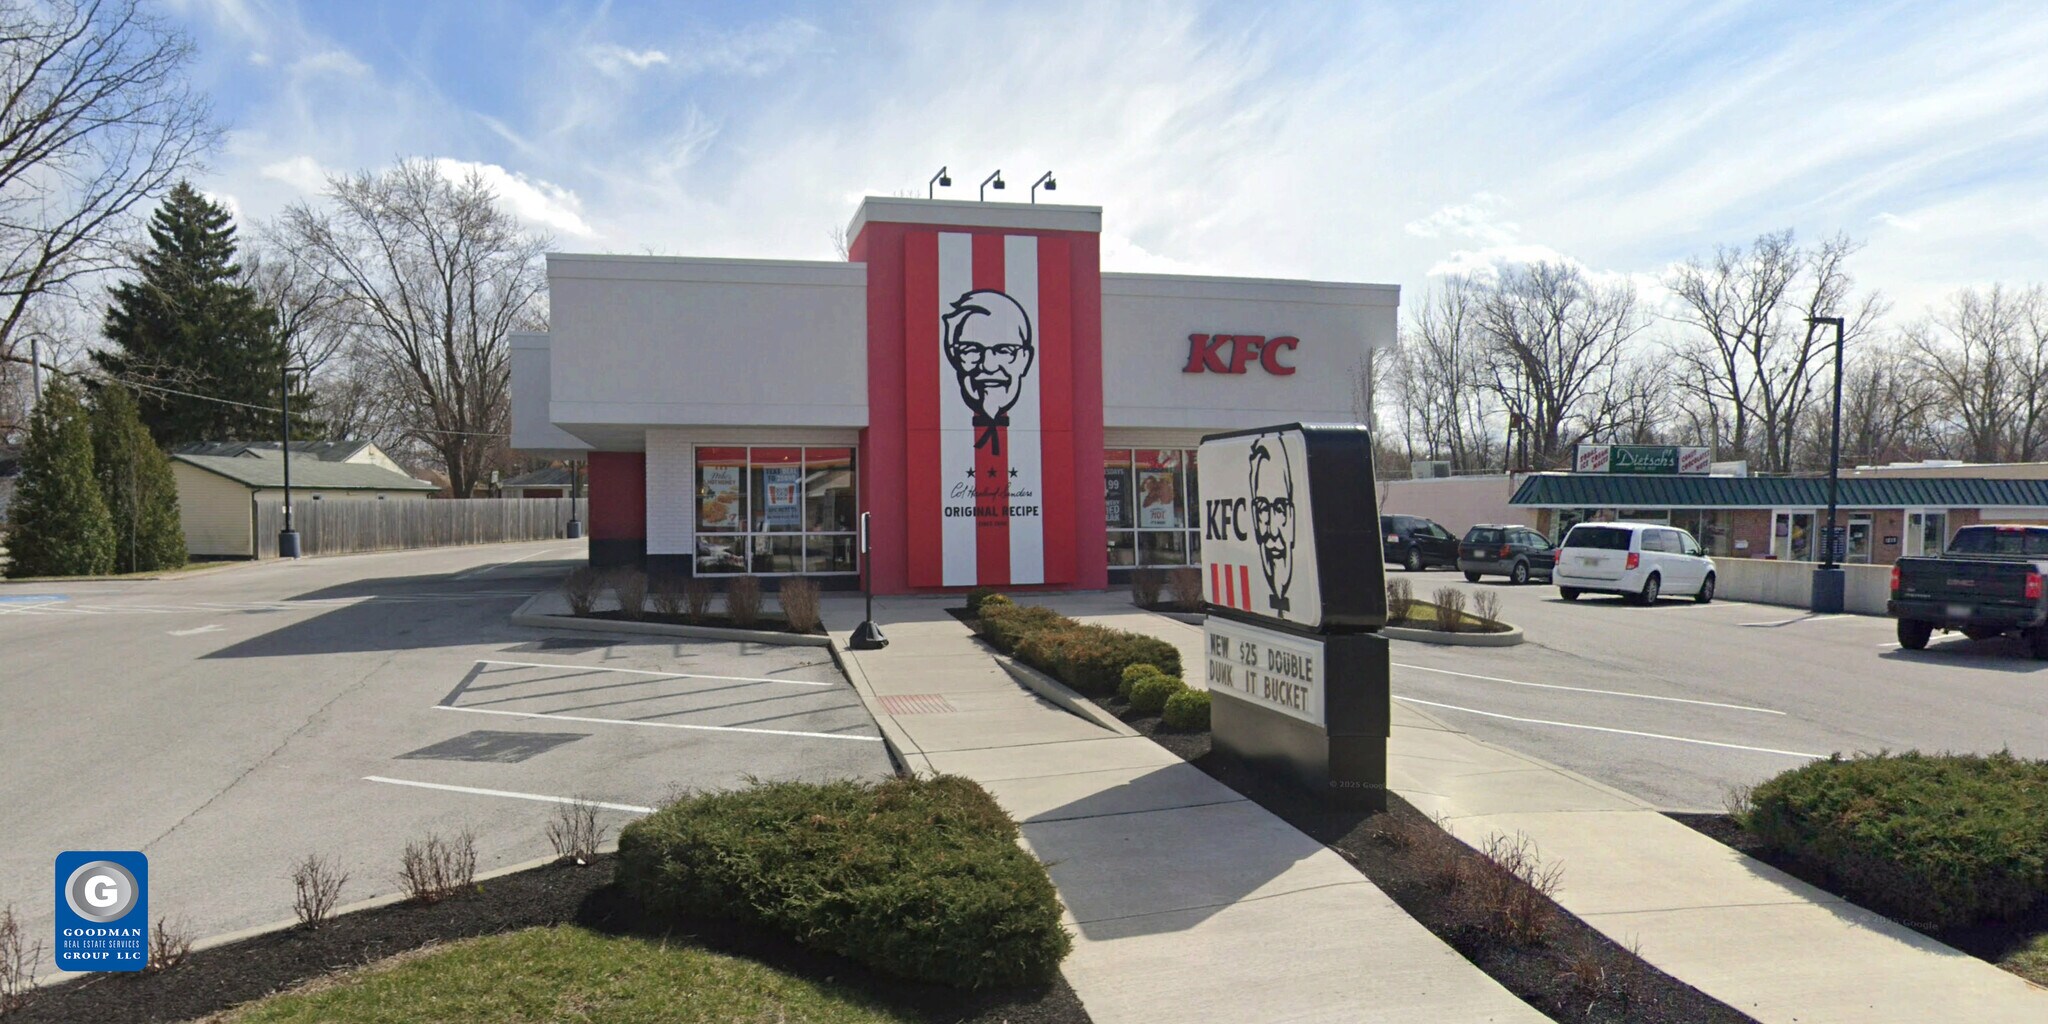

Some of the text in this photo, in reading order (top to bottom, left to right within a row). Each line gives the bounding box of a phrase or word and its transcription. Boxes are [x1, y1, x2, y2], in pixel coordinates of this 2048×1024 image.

[1182, 333, 1300, 376] KFC
[1616, 448, 1675, 467] Dietsch's
[944, 505, 1039, 518] ORIGINAL RECIPE
[1206, 497, 1248, 541] KFC
[1209, 633, 1230, 659] NEW
[1239, 641, 1258, 666] $25
[1209, 660, 1309, 711] DUNK IT BUCKET
